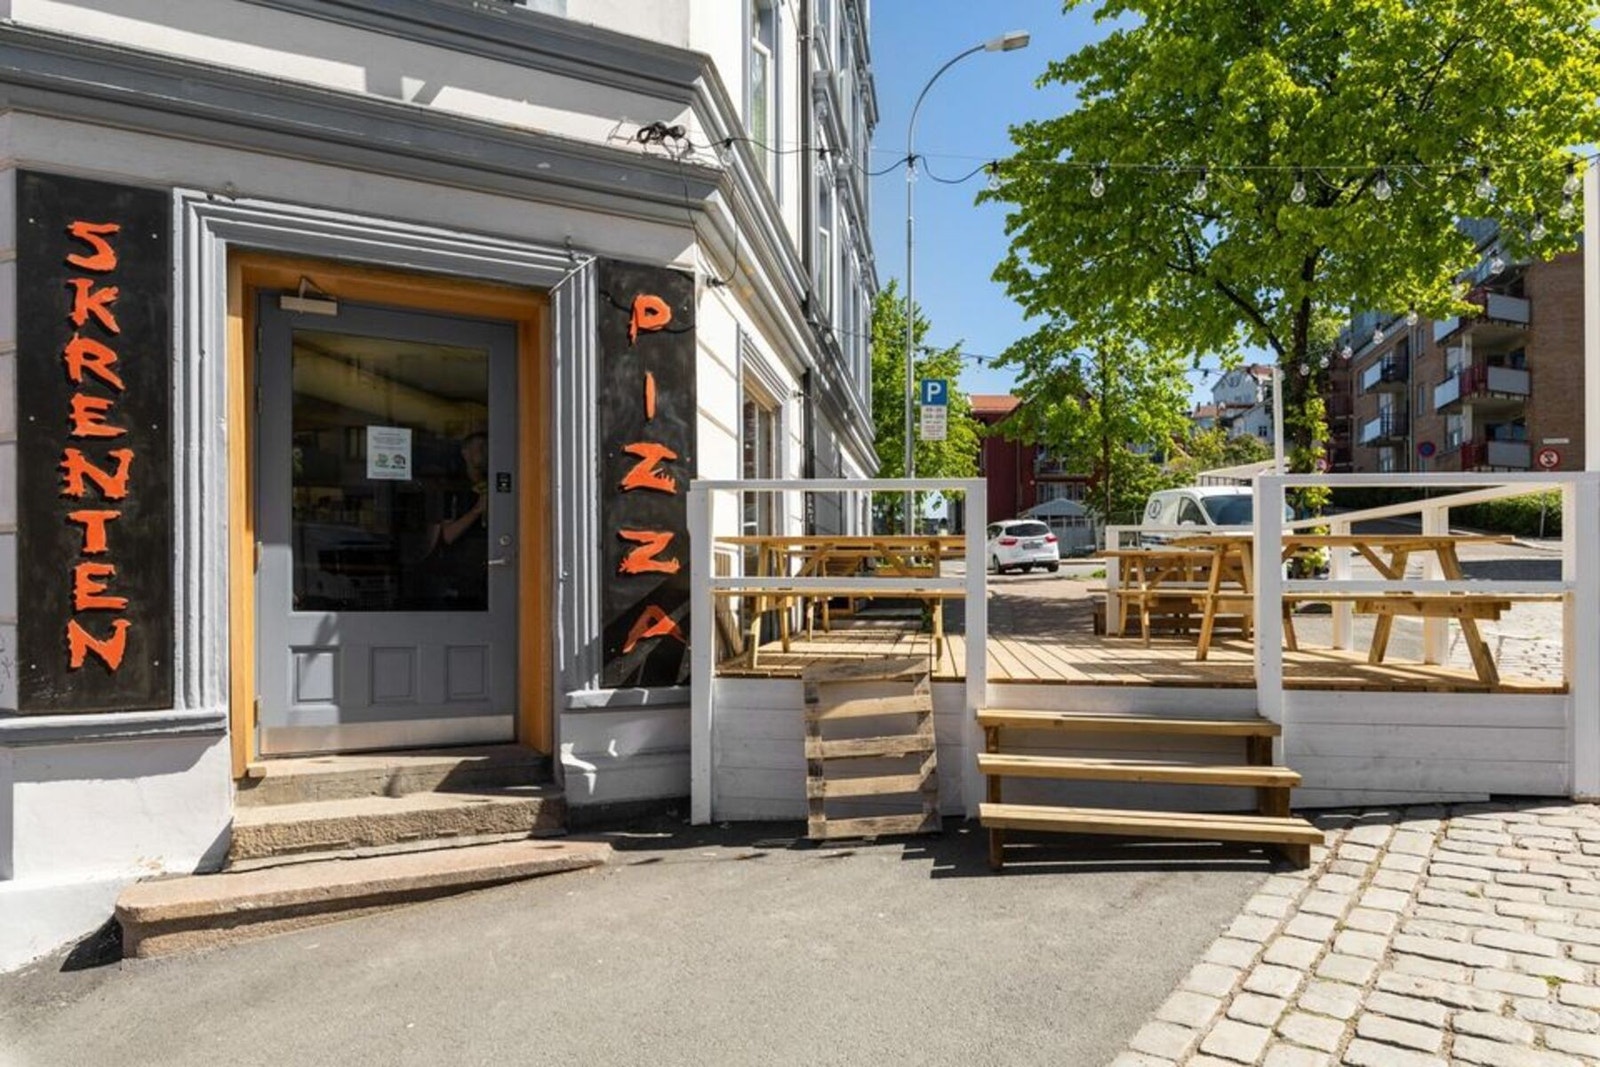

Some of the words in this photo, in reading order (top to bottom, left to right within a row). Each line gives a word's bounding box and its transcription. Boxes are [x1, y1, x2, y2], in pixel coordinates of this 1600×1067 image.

[62, 219, 133, 671] SKRENTEN
[619, 293, 686, 653] PIZZA
[927, 381, 942, 402] P
